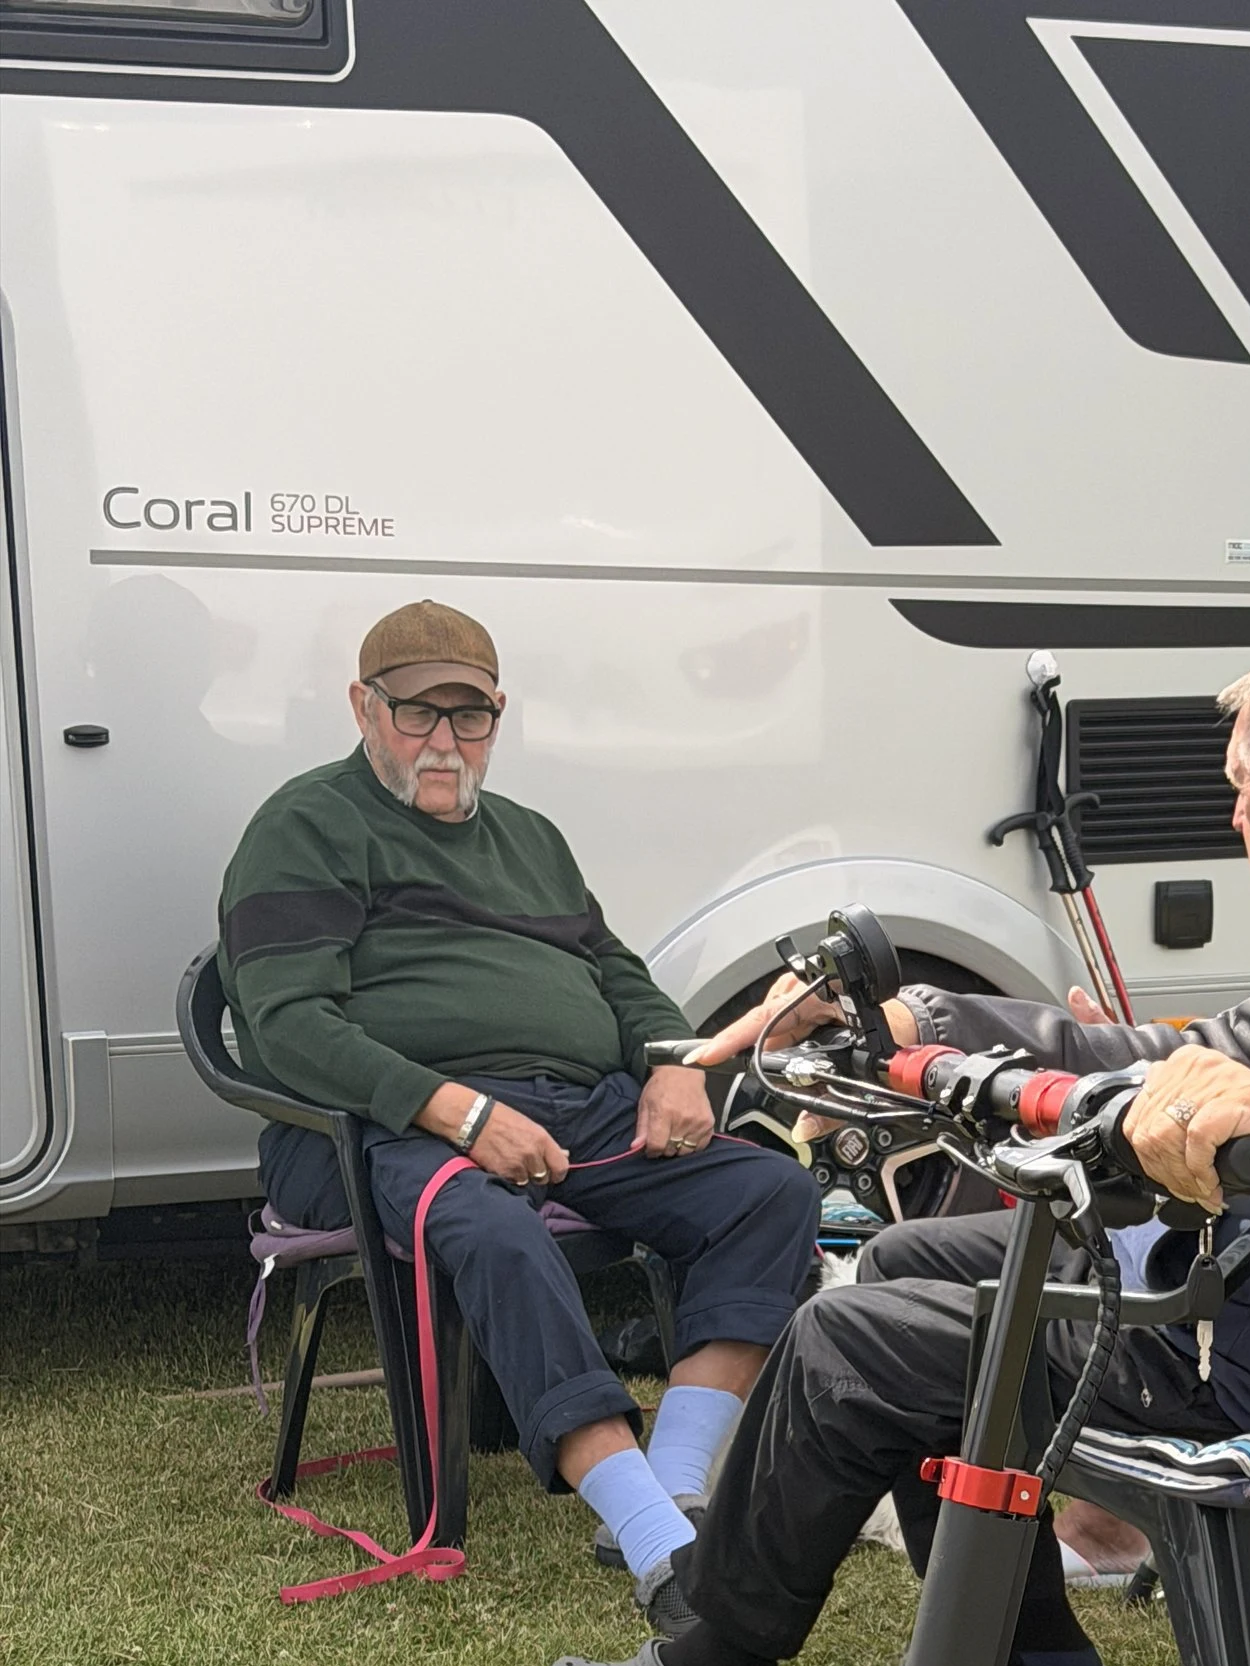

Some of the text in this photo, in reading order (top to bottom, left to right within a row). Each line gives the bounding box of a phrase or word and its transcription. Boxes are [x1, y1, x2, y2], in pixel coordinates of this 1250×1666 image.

[102, 486, 252, 532] Coral
[270, 493, 360, 515] 670 DL
[271, 514, 395, 537] SUPREME
